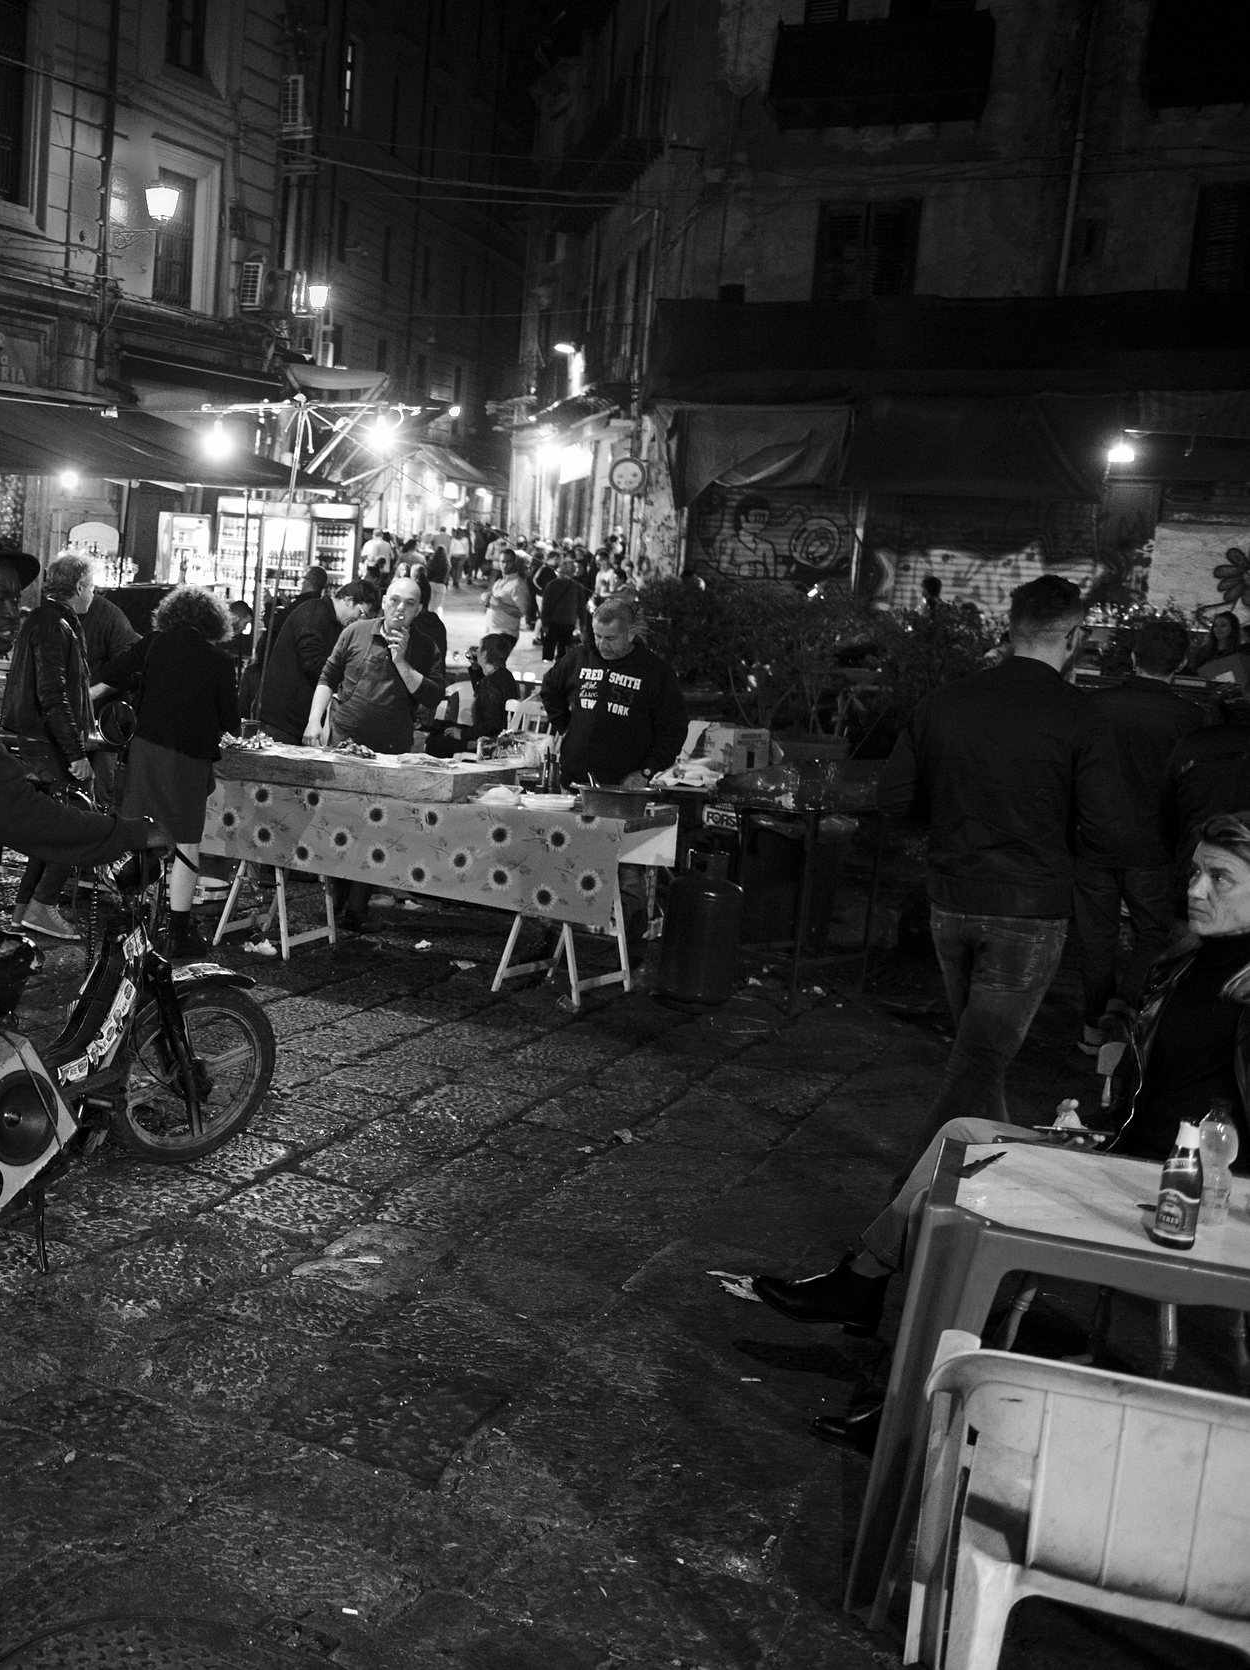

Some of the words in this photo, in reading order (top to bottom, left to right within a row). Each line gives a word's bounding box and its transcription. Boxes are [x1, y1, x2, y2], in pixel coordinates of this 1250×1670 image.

[579, 667, 604, 681] FRED
[608, 671, 643, 691] SMITH
[607, 701, 630, 717] YORK
[706, 811, 738, 828] FORS
